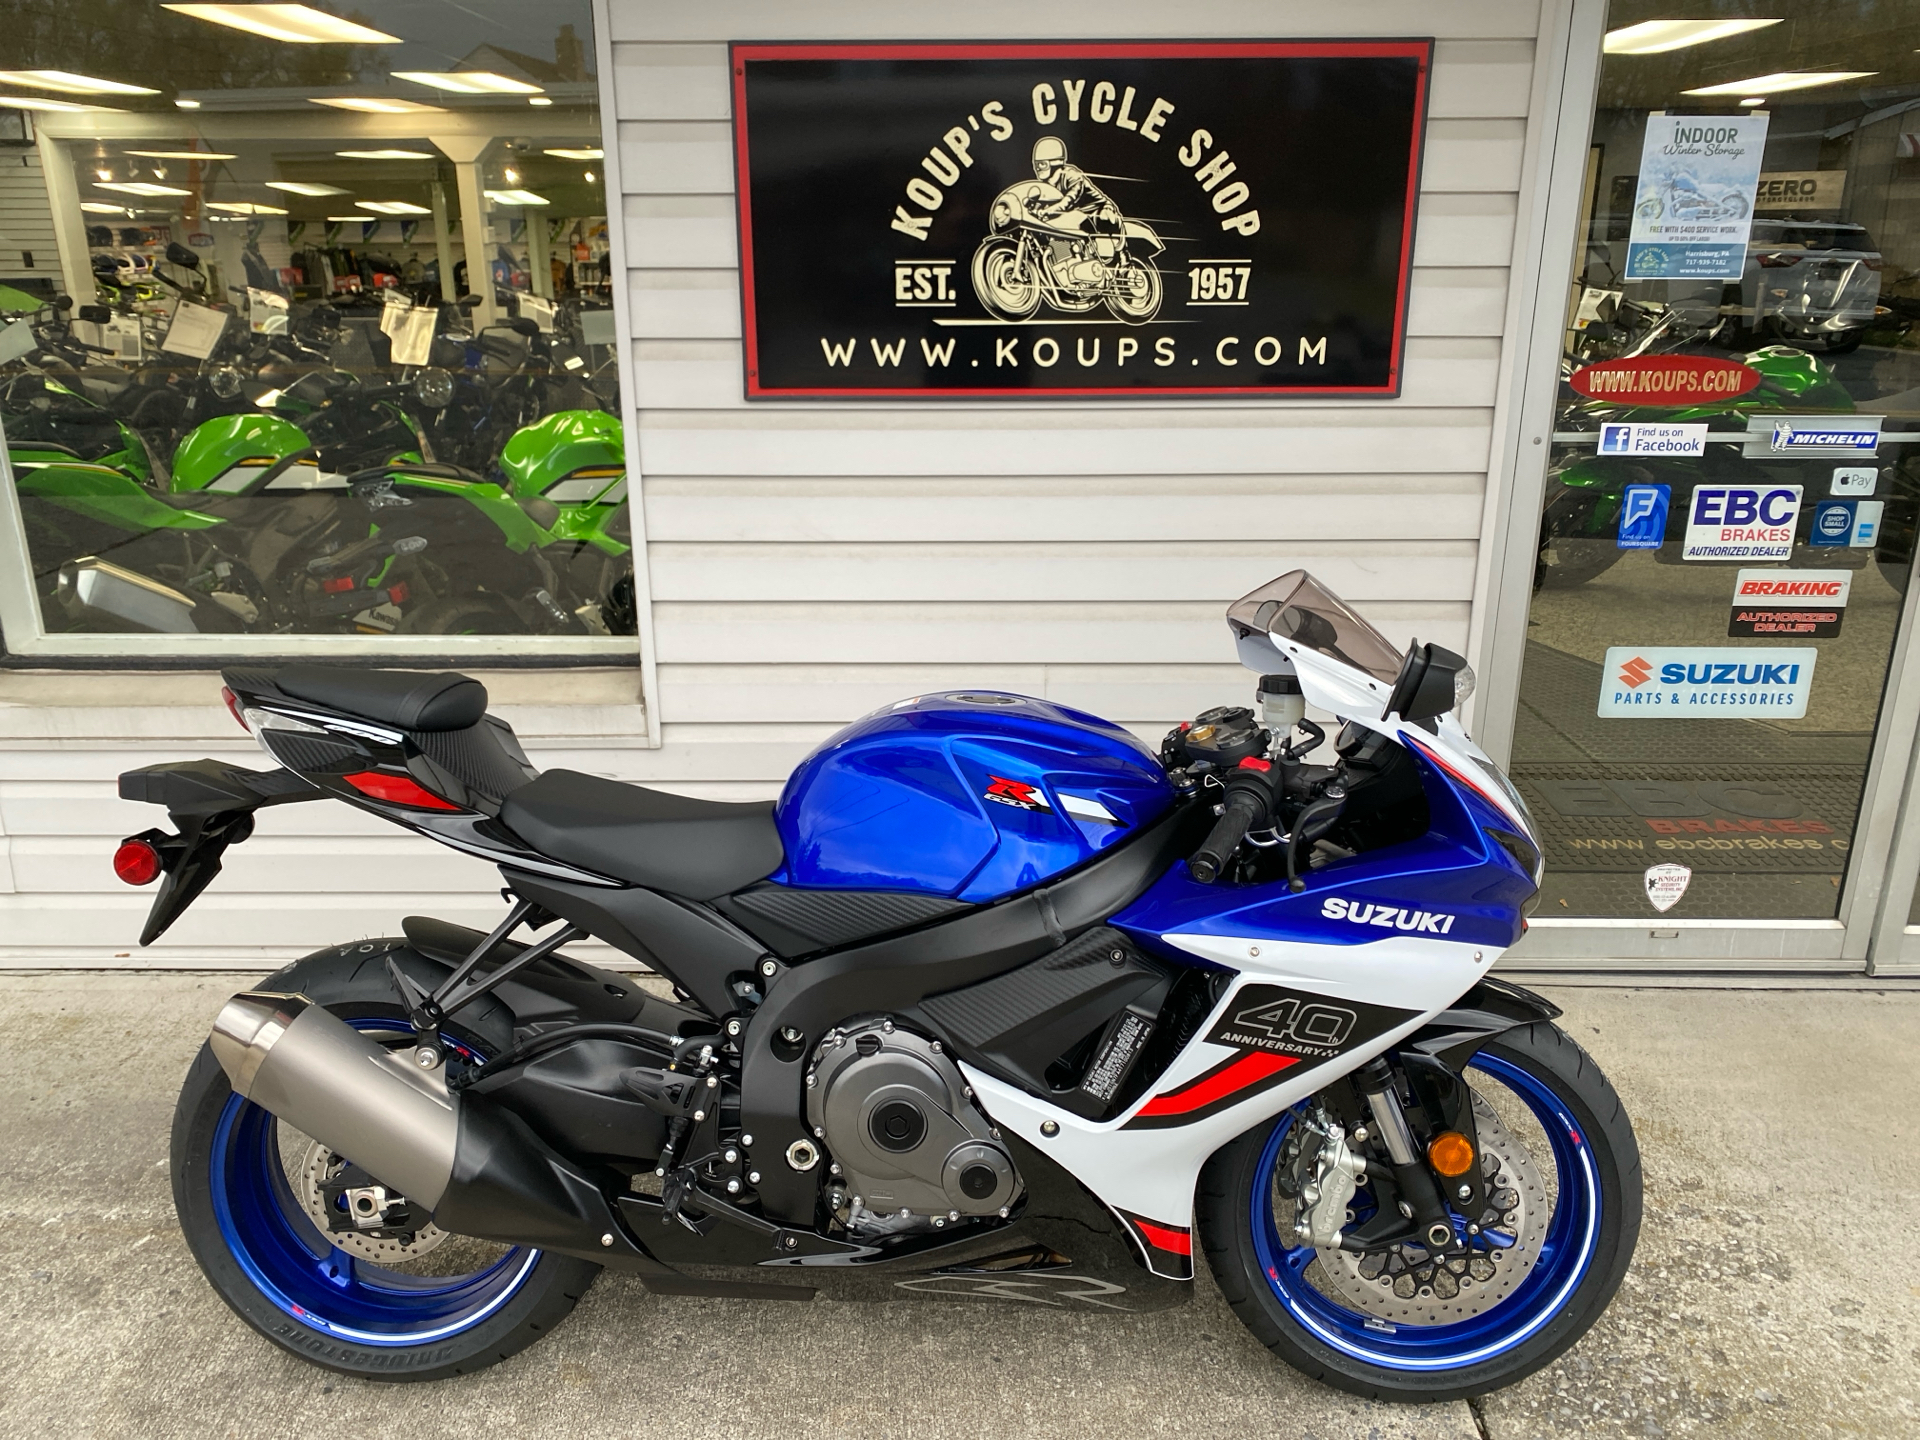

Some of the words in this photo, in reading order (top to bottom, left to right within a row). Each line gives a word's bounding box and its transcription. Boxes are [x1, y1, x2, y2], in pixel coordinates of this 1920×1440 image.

[1663, 143, 1702, 156] Winter
[1704, 143, 1745, 160] Storage
[891, 101, 1013, 242] KOUP'S
[1033, 80, 1175, 143] CYCLE
[1179, 129, 1260, 238] SHOP
[1756, 179, 1817, 196] ZERO
[1680, 226, 1695, 234] $400
[895, 266, 956, 301] EST.
[1189, 267, 1251, 301] 1957
[1589, 370, 1742, 392] WWW.KOUPS.COM
[1637, 428, 1656, 437] Find
[1793, 434, 1876, 446] MICHELIN
[1635, 438, 1700, 452] Facebook
[1851, 474, 1872, 489] Pay
[1693, 490, 1797, 526] EBC
[1720, 529, 1791, 541] BRAKES
[1689, 547, 1750, 556] AUTHORIZED
[1751, 547, 1789, 556] DEALER
[1740, 582, 1842, 596] BRAKING
[1737, 612, 1837, 622] AUTHORIZED
[1754, 623, 1816, 632] DEALER
[1660, 663, 1800, 684] SUZUKI
[1614, 692, 1662, 704] PARTS
[1671, 693, 1679, 704] &
[1689, 692, 1794, 705] ACCESSORIES
[1644, 819, 1835, 834] BRAKES
[1321, 897, 1455, 934] SUZUKI
[1233, 998, 1357, 1047] 40
[1327, 1036, 1339, 1044] th
[1220, 1032, 1323, 1056] ANNIVERSARY
[1318, 1174, 1346, 1233] brembo
